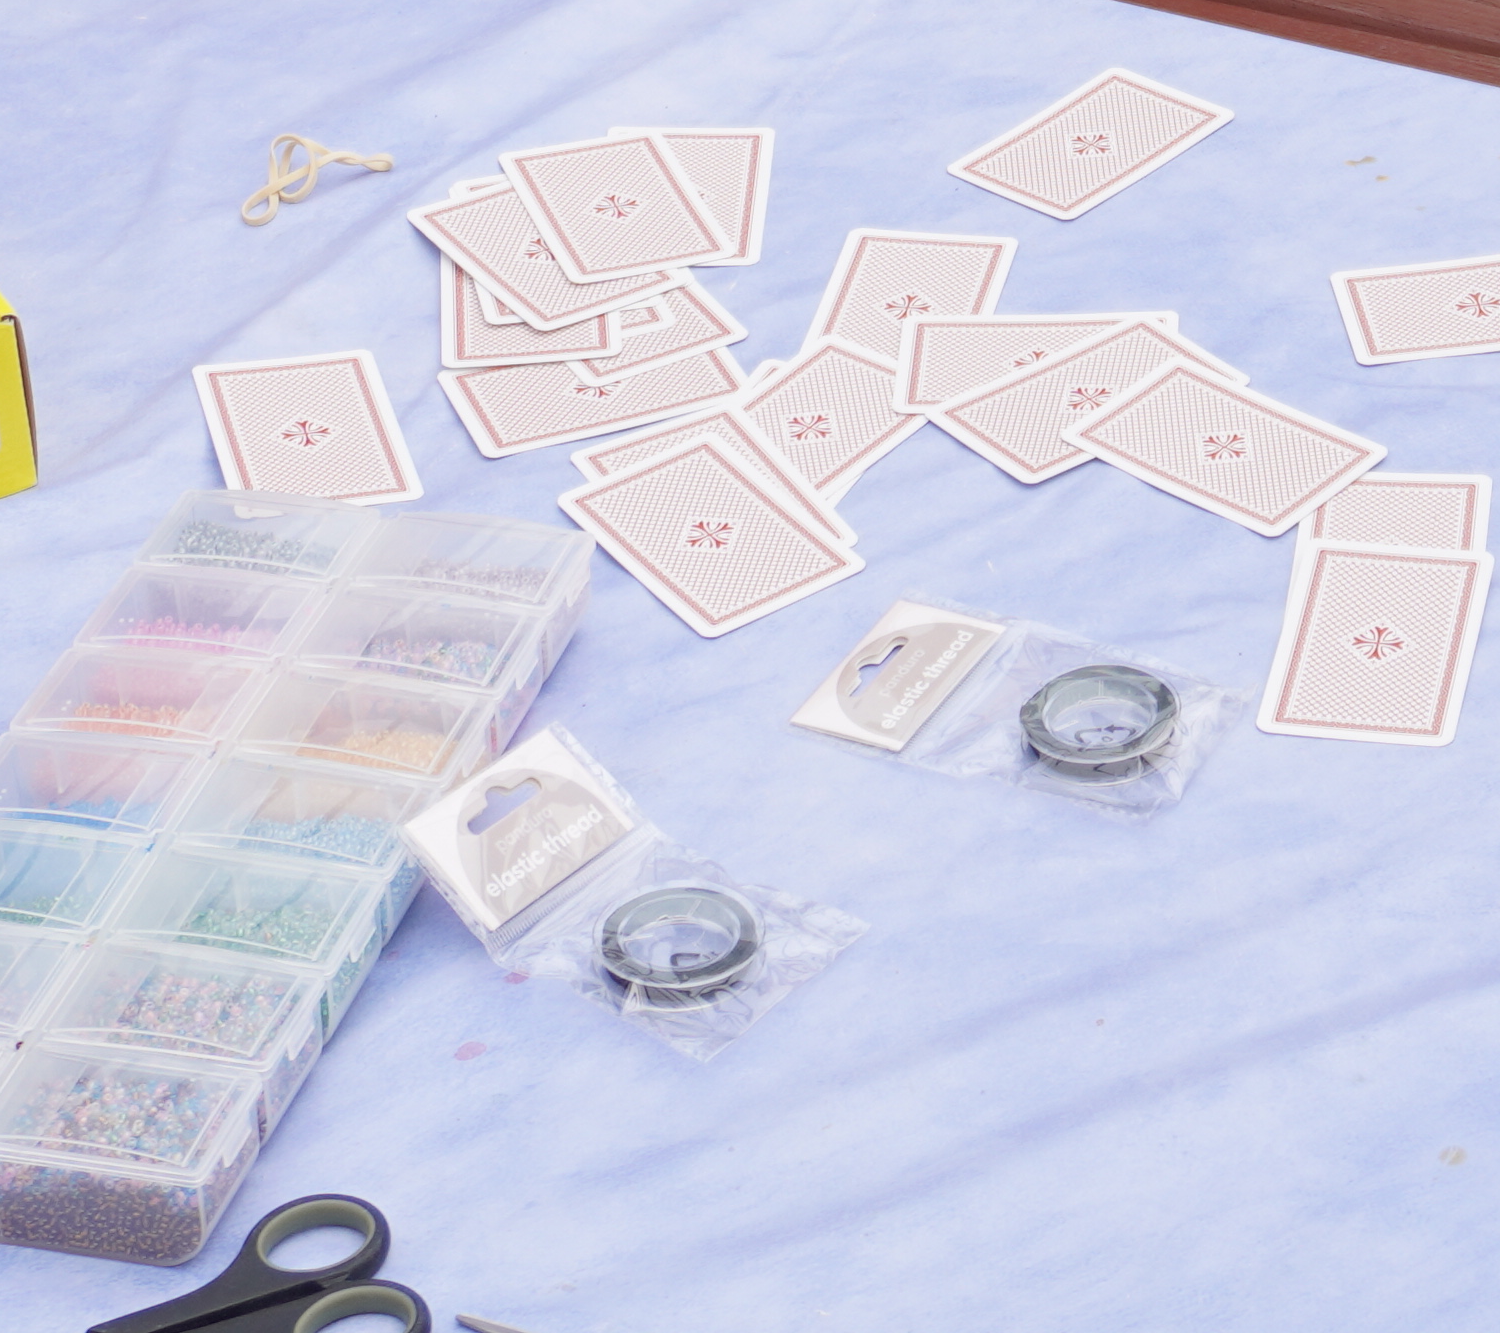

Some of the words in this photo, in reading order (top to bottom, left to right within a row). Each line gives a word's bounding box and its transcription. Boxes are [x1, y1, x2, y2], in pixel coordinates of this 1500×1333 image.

[878, 647, 927, 699] panduro
[880, 678, 930, 730] elastic
[922, 628, 975, 679] thread
[485, 849, 546, 898] elastic
[541, 803, 604, 856] thread
[495, 806, 554, 855] panduro
